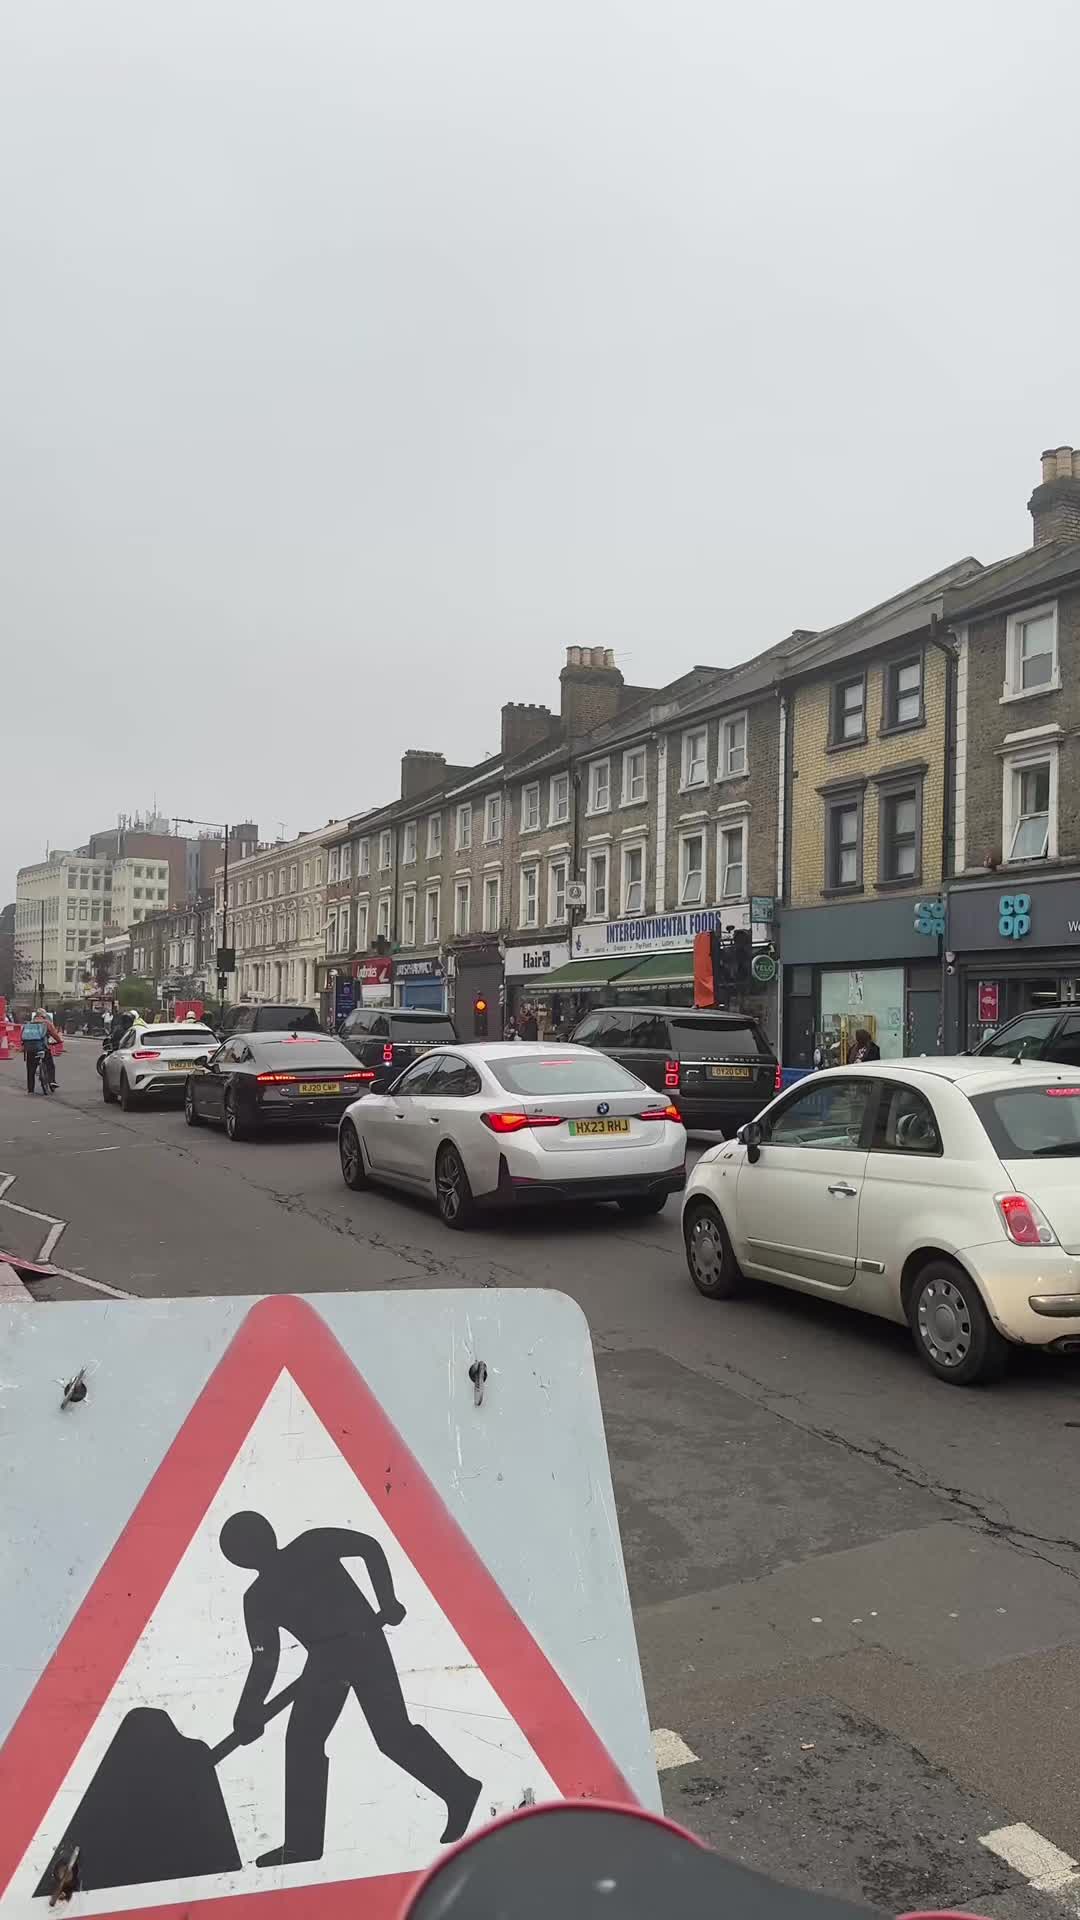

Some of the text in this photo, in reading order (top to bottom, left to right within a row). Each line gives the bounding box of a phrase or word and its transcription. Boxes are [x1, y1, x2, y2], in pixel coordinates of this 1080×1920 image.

[606, 911, 721, 944] INTERCONTINENTAL FOODS
[523, 951, 542, 968] Hair
[576, 1119, 629, 1134] HX23 RHJ
